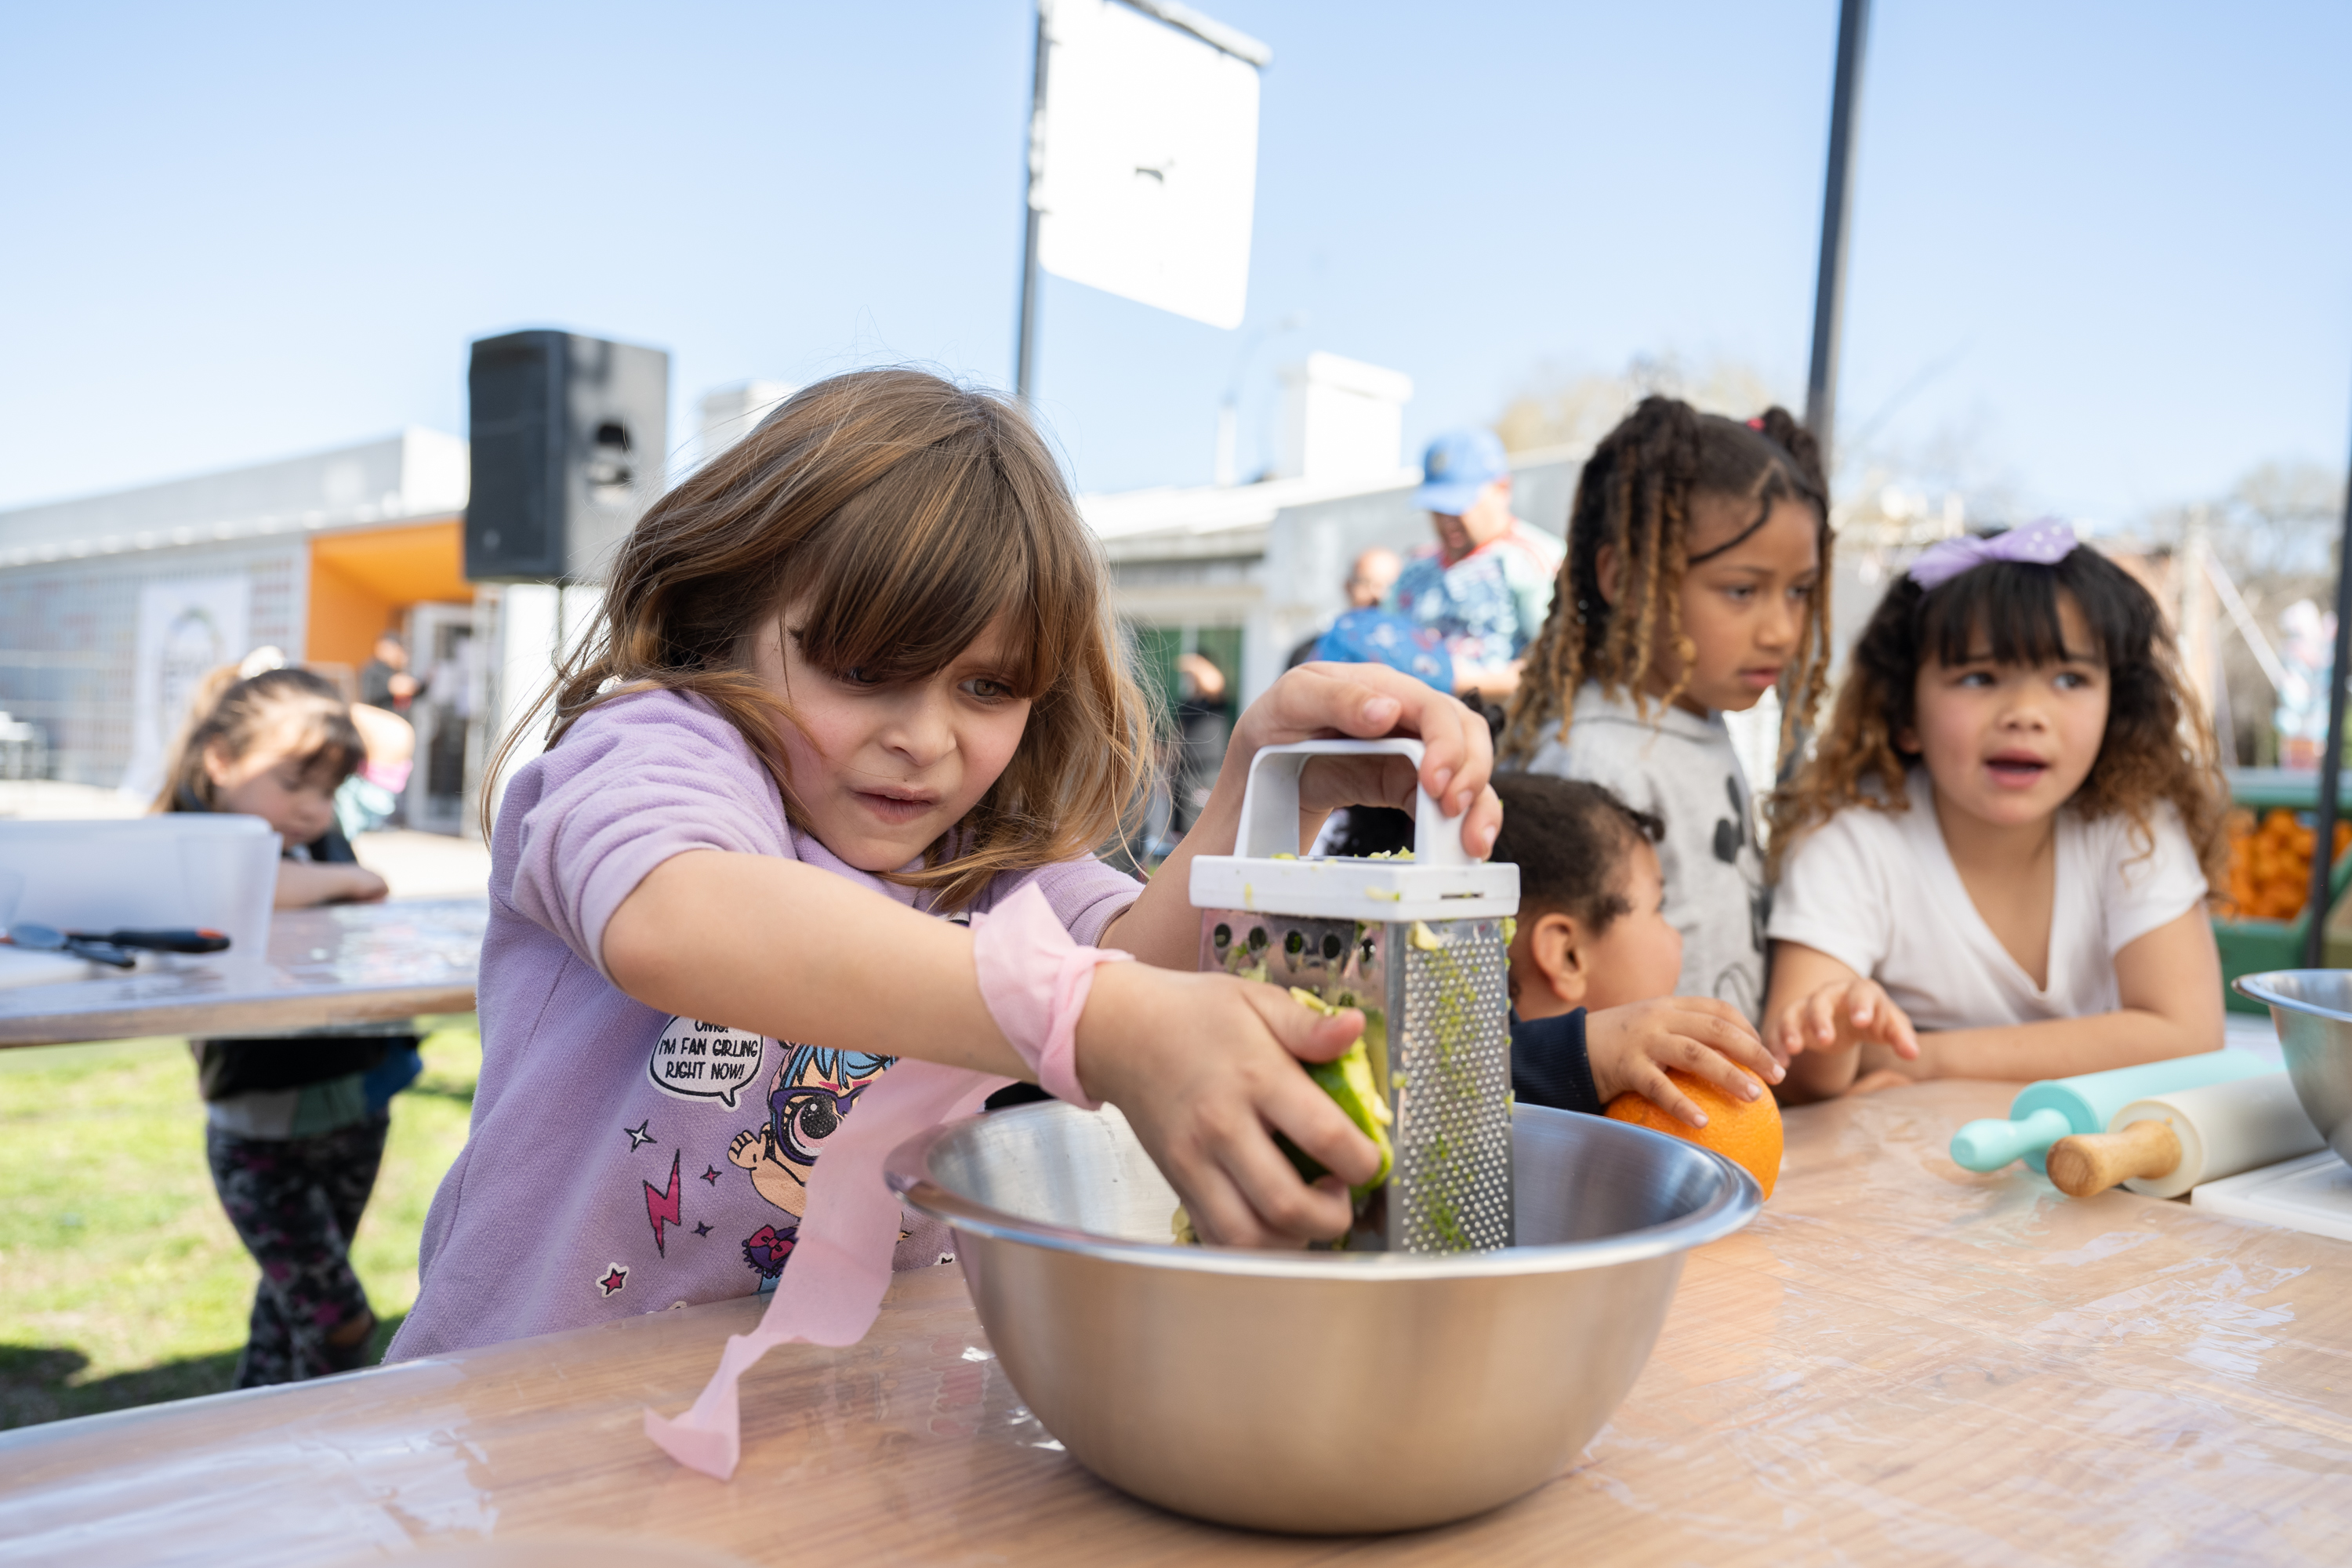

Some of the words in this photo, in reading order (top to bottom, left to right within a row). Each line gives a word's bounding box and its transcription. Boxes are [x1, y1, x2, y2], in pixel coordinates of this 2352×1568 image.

[659, 1038, 676, 1055] I'M
[681, 1037, 706, 1055] FAN
[712, 1039, 757, 1057] GIRLING
[665, 1061, 706, 1079] RIGHT
[710, 1063, 745, 1080] NOW!
